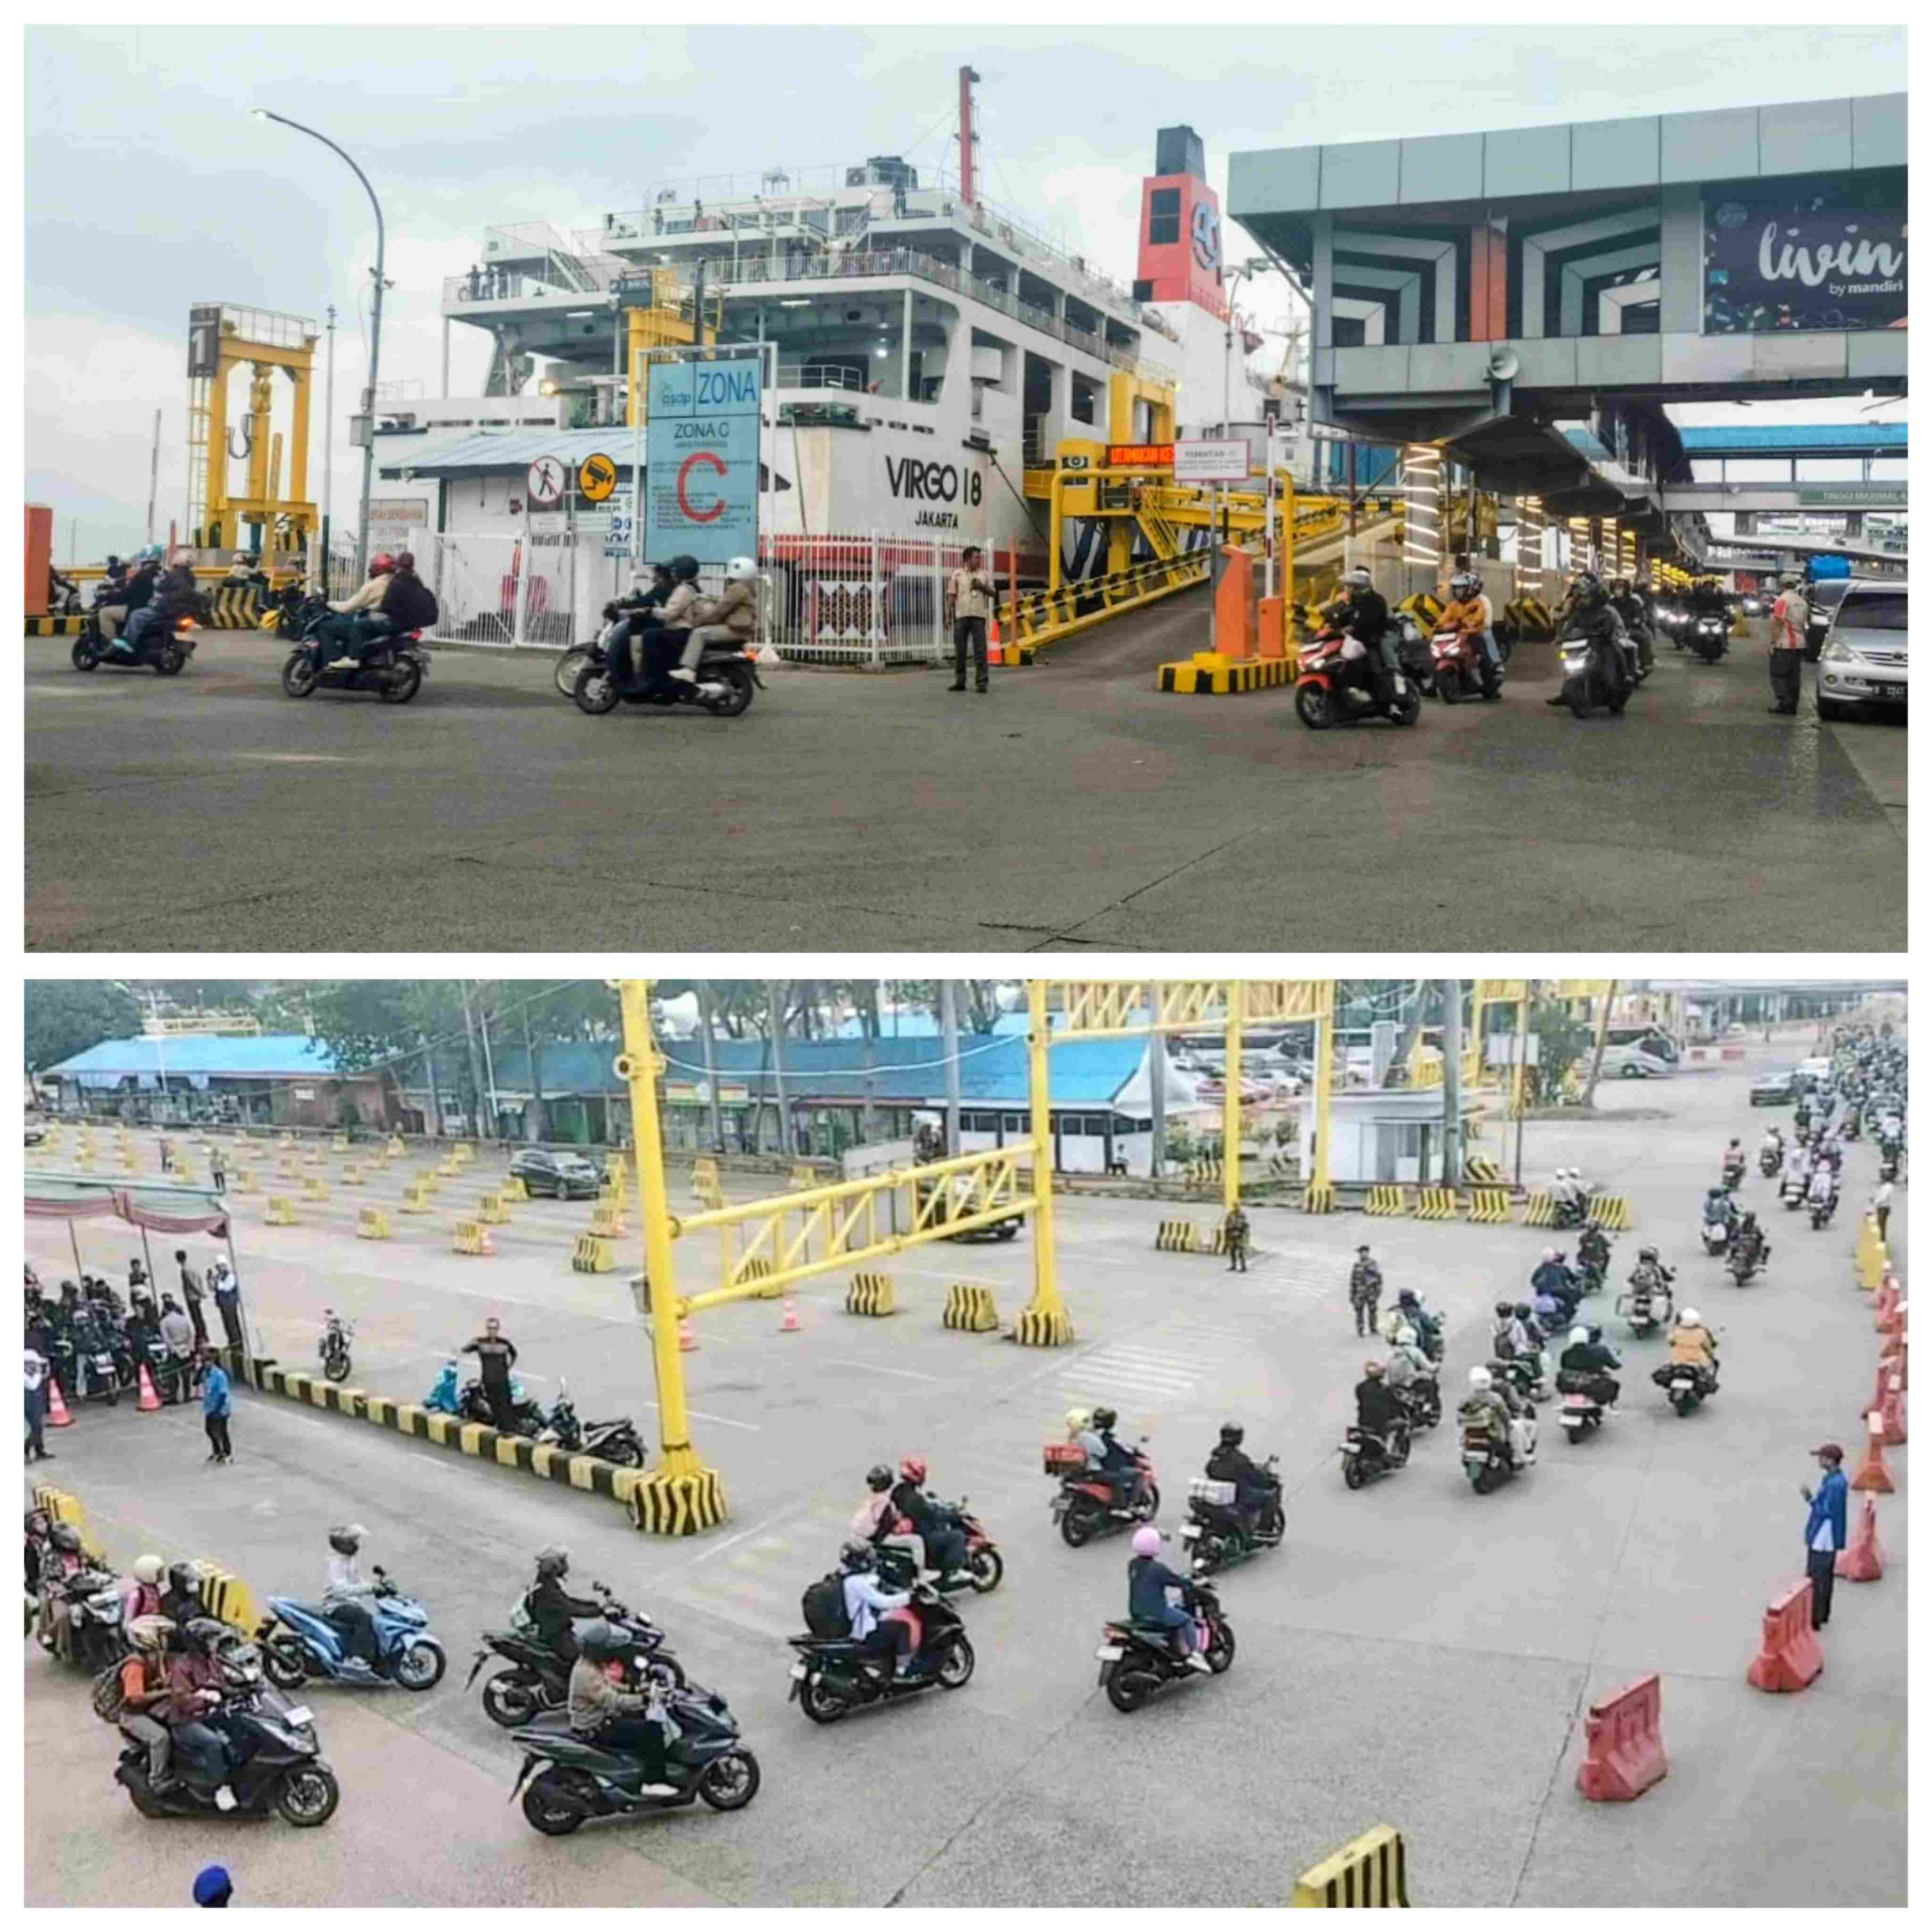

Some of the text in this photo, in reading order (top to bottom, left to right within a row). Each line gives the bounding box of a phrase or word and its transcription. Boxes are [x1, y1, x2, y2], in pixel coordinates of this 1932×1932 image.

[1829, 280, 1903, 297] by mandiri
[697, 371, 756, 404] ZONA
[662, 391, 691, 407] asdp
[674, 423, 715, 439] ZONA
[677, 451, 728, 522] C
[885, 455, 982, 507] VIRGO 18
[915, 510, 958, 529] JAKARTA
